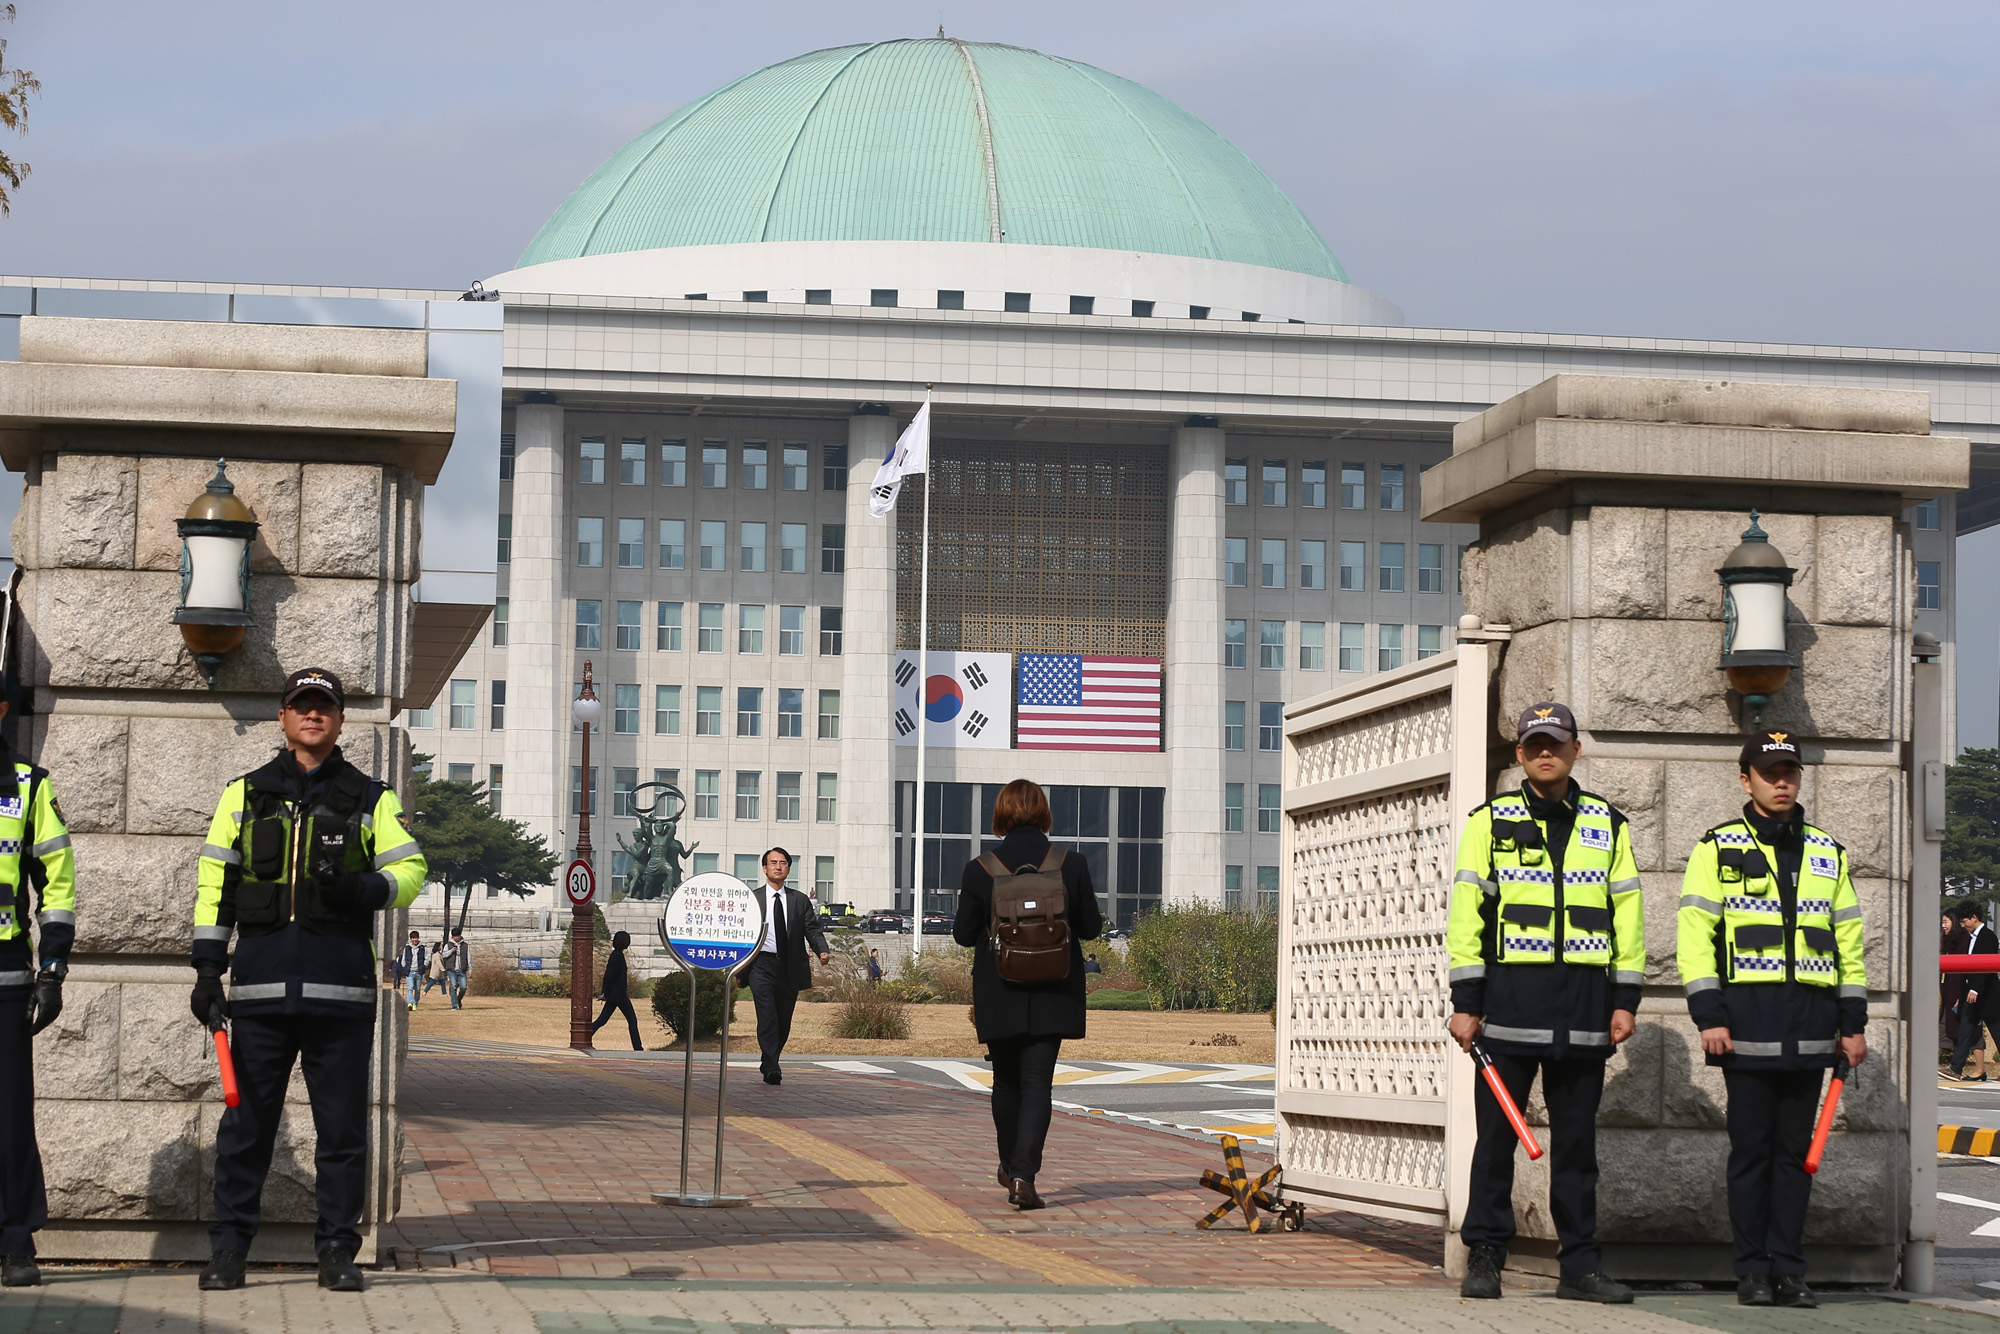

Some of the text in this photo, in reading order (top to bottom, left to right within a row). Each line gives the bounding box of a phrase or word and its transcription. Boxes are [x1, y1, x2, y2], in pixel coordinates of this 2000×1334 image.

[296, 677, 333, 689] POLICE
[1527, 716, 1561, 728] POLICE
[1761, 743, 1796, 752] POLICE
[1583, 839, 1608, 848] POLICE
[1813, 867, 1836, 876] POLICE
[571, 873, 588, 893] 30
[683, 887, 749, 899] 국회 안전을 위하여
[684, 899, 748, 912] 신분증 패용 및
[685, 913, 744, 927] 출입자 확인에
[670, 926, 756, 939] 협조해 주시기 바랍니다.
[687, 948, 737, 960] 국회사무처
